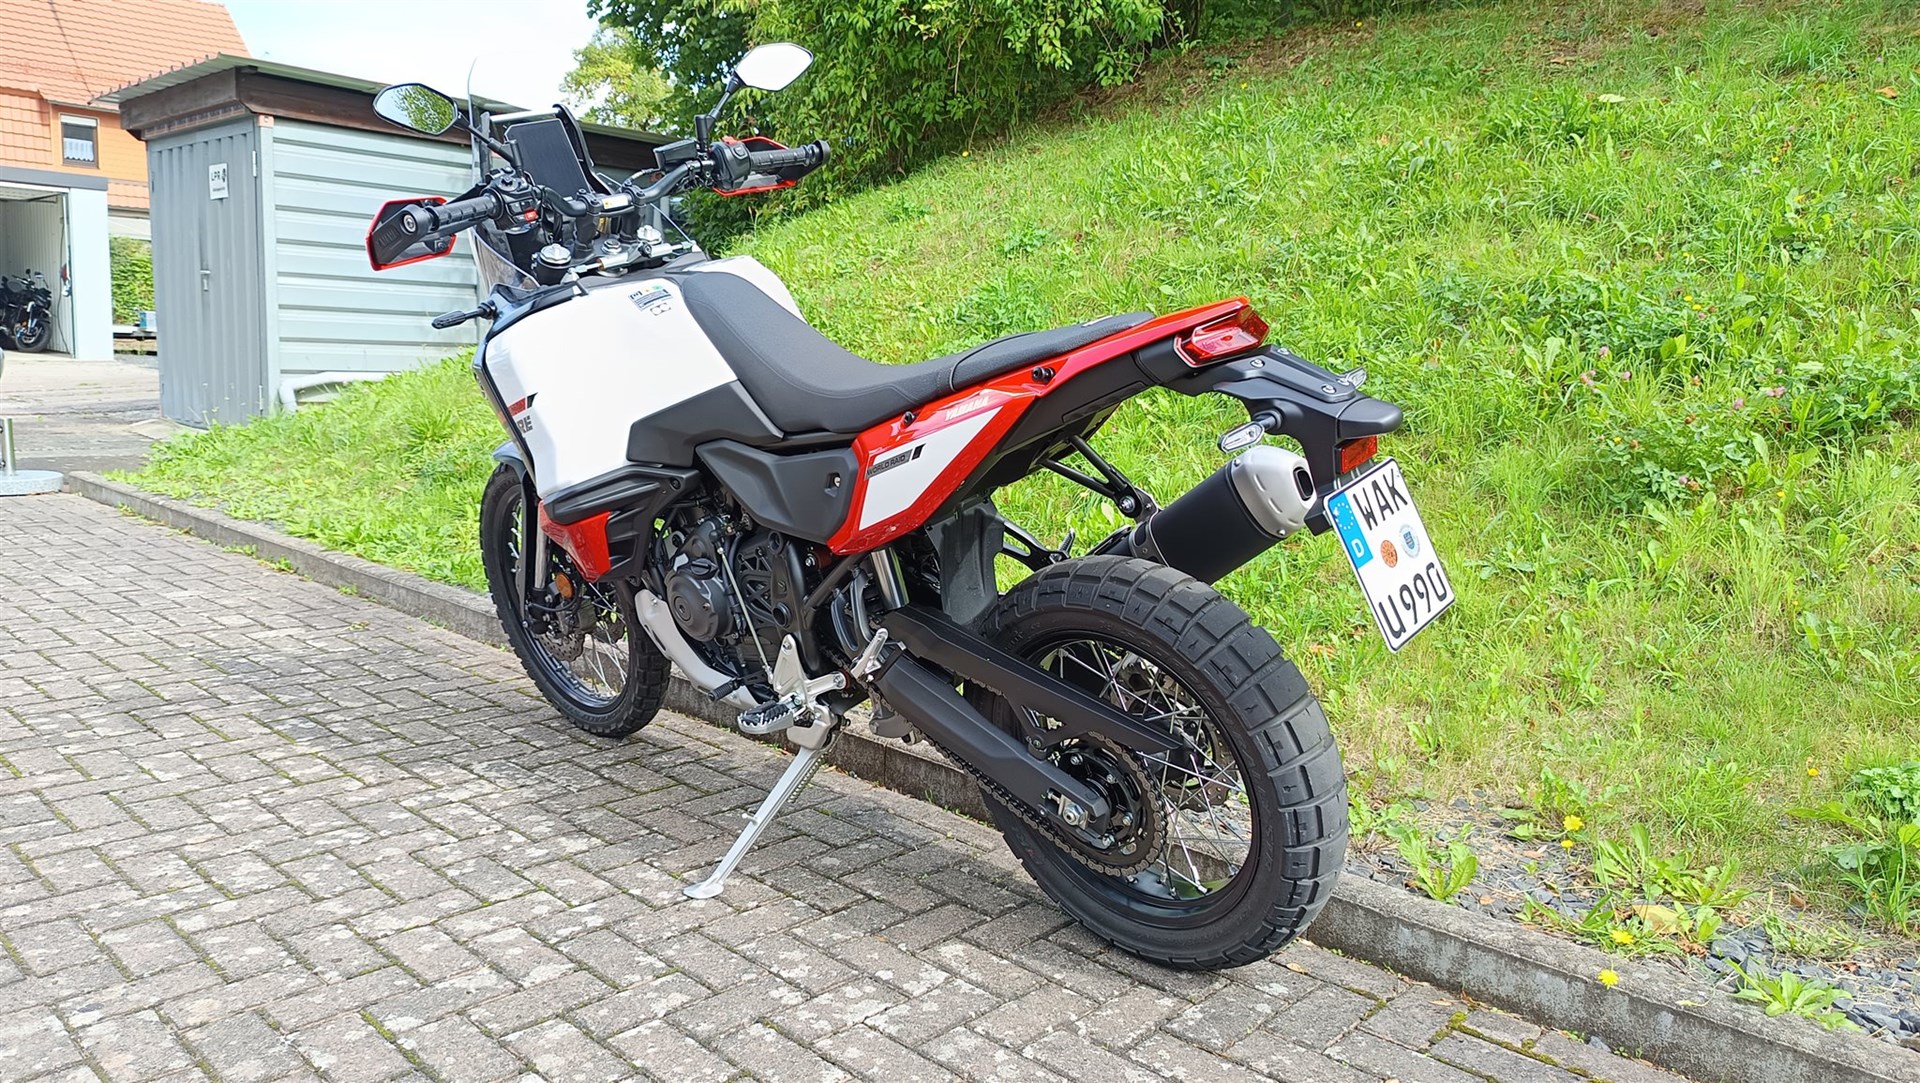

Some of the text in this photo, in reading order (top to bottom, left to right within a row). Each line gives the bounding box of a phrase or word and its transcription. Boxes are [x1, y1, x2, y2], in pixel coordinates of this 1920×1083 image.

[944, 396, 989, 421] YAMAHA
[867, 454, 906, 476] WORLD RAID
[1352, 468, 1408, 531] WAK
[1351, 539, 1365, 558] D
